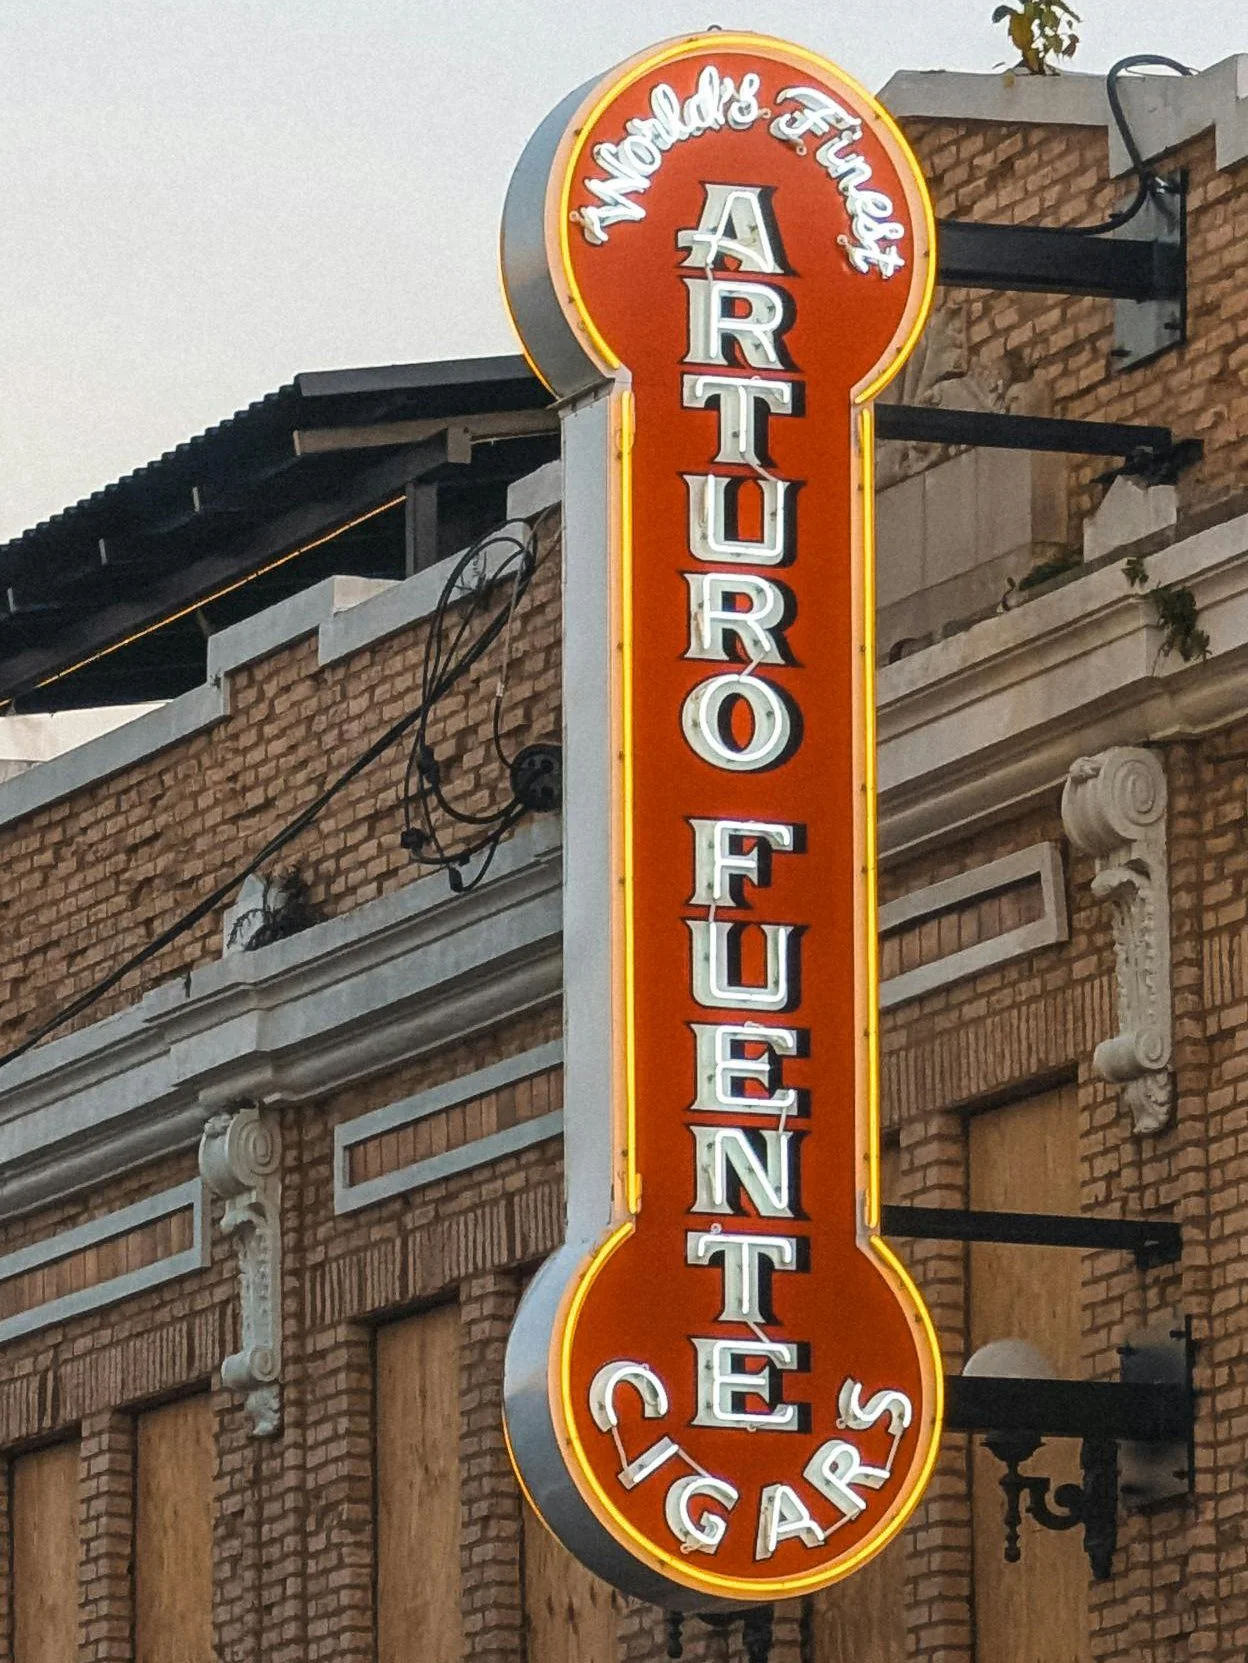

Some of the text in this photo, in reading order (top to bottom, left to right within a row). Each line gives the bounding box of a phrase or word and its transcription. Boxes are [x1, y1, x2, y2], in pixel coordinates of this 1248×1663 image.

[569, 64, 907, 279] World's Finest
[676, 182, 811, 1433] ARTURO FUENTE
[588, 1358, 914, 1561] CIGARS
